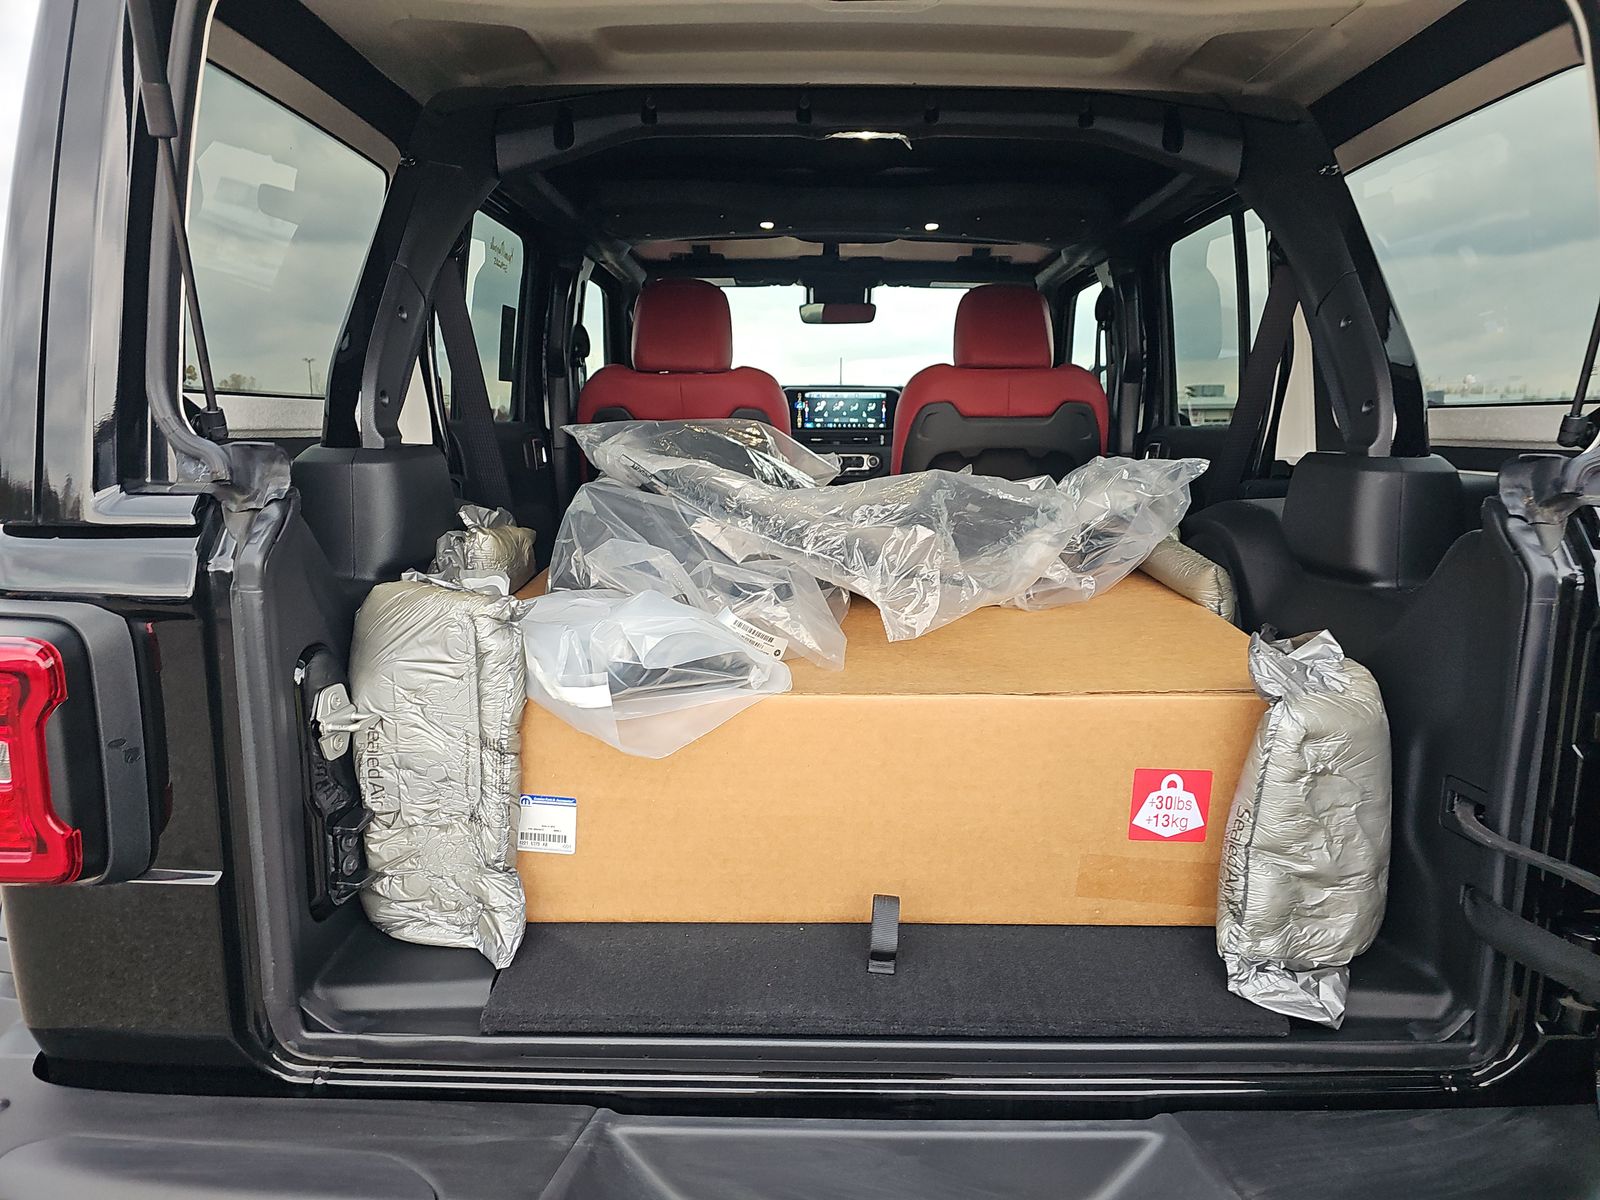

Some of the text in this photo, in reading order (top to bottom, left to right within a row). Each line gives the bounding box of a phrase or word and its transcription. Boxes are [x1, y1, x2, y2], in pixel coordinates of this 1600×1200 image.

[367, 780, 386, 807] Air
[1148, 795, 1193, 811] +30lbs
[1145, 813, 1189, 832] +13kg
[1227, 804, 1253, 871] Sealed
